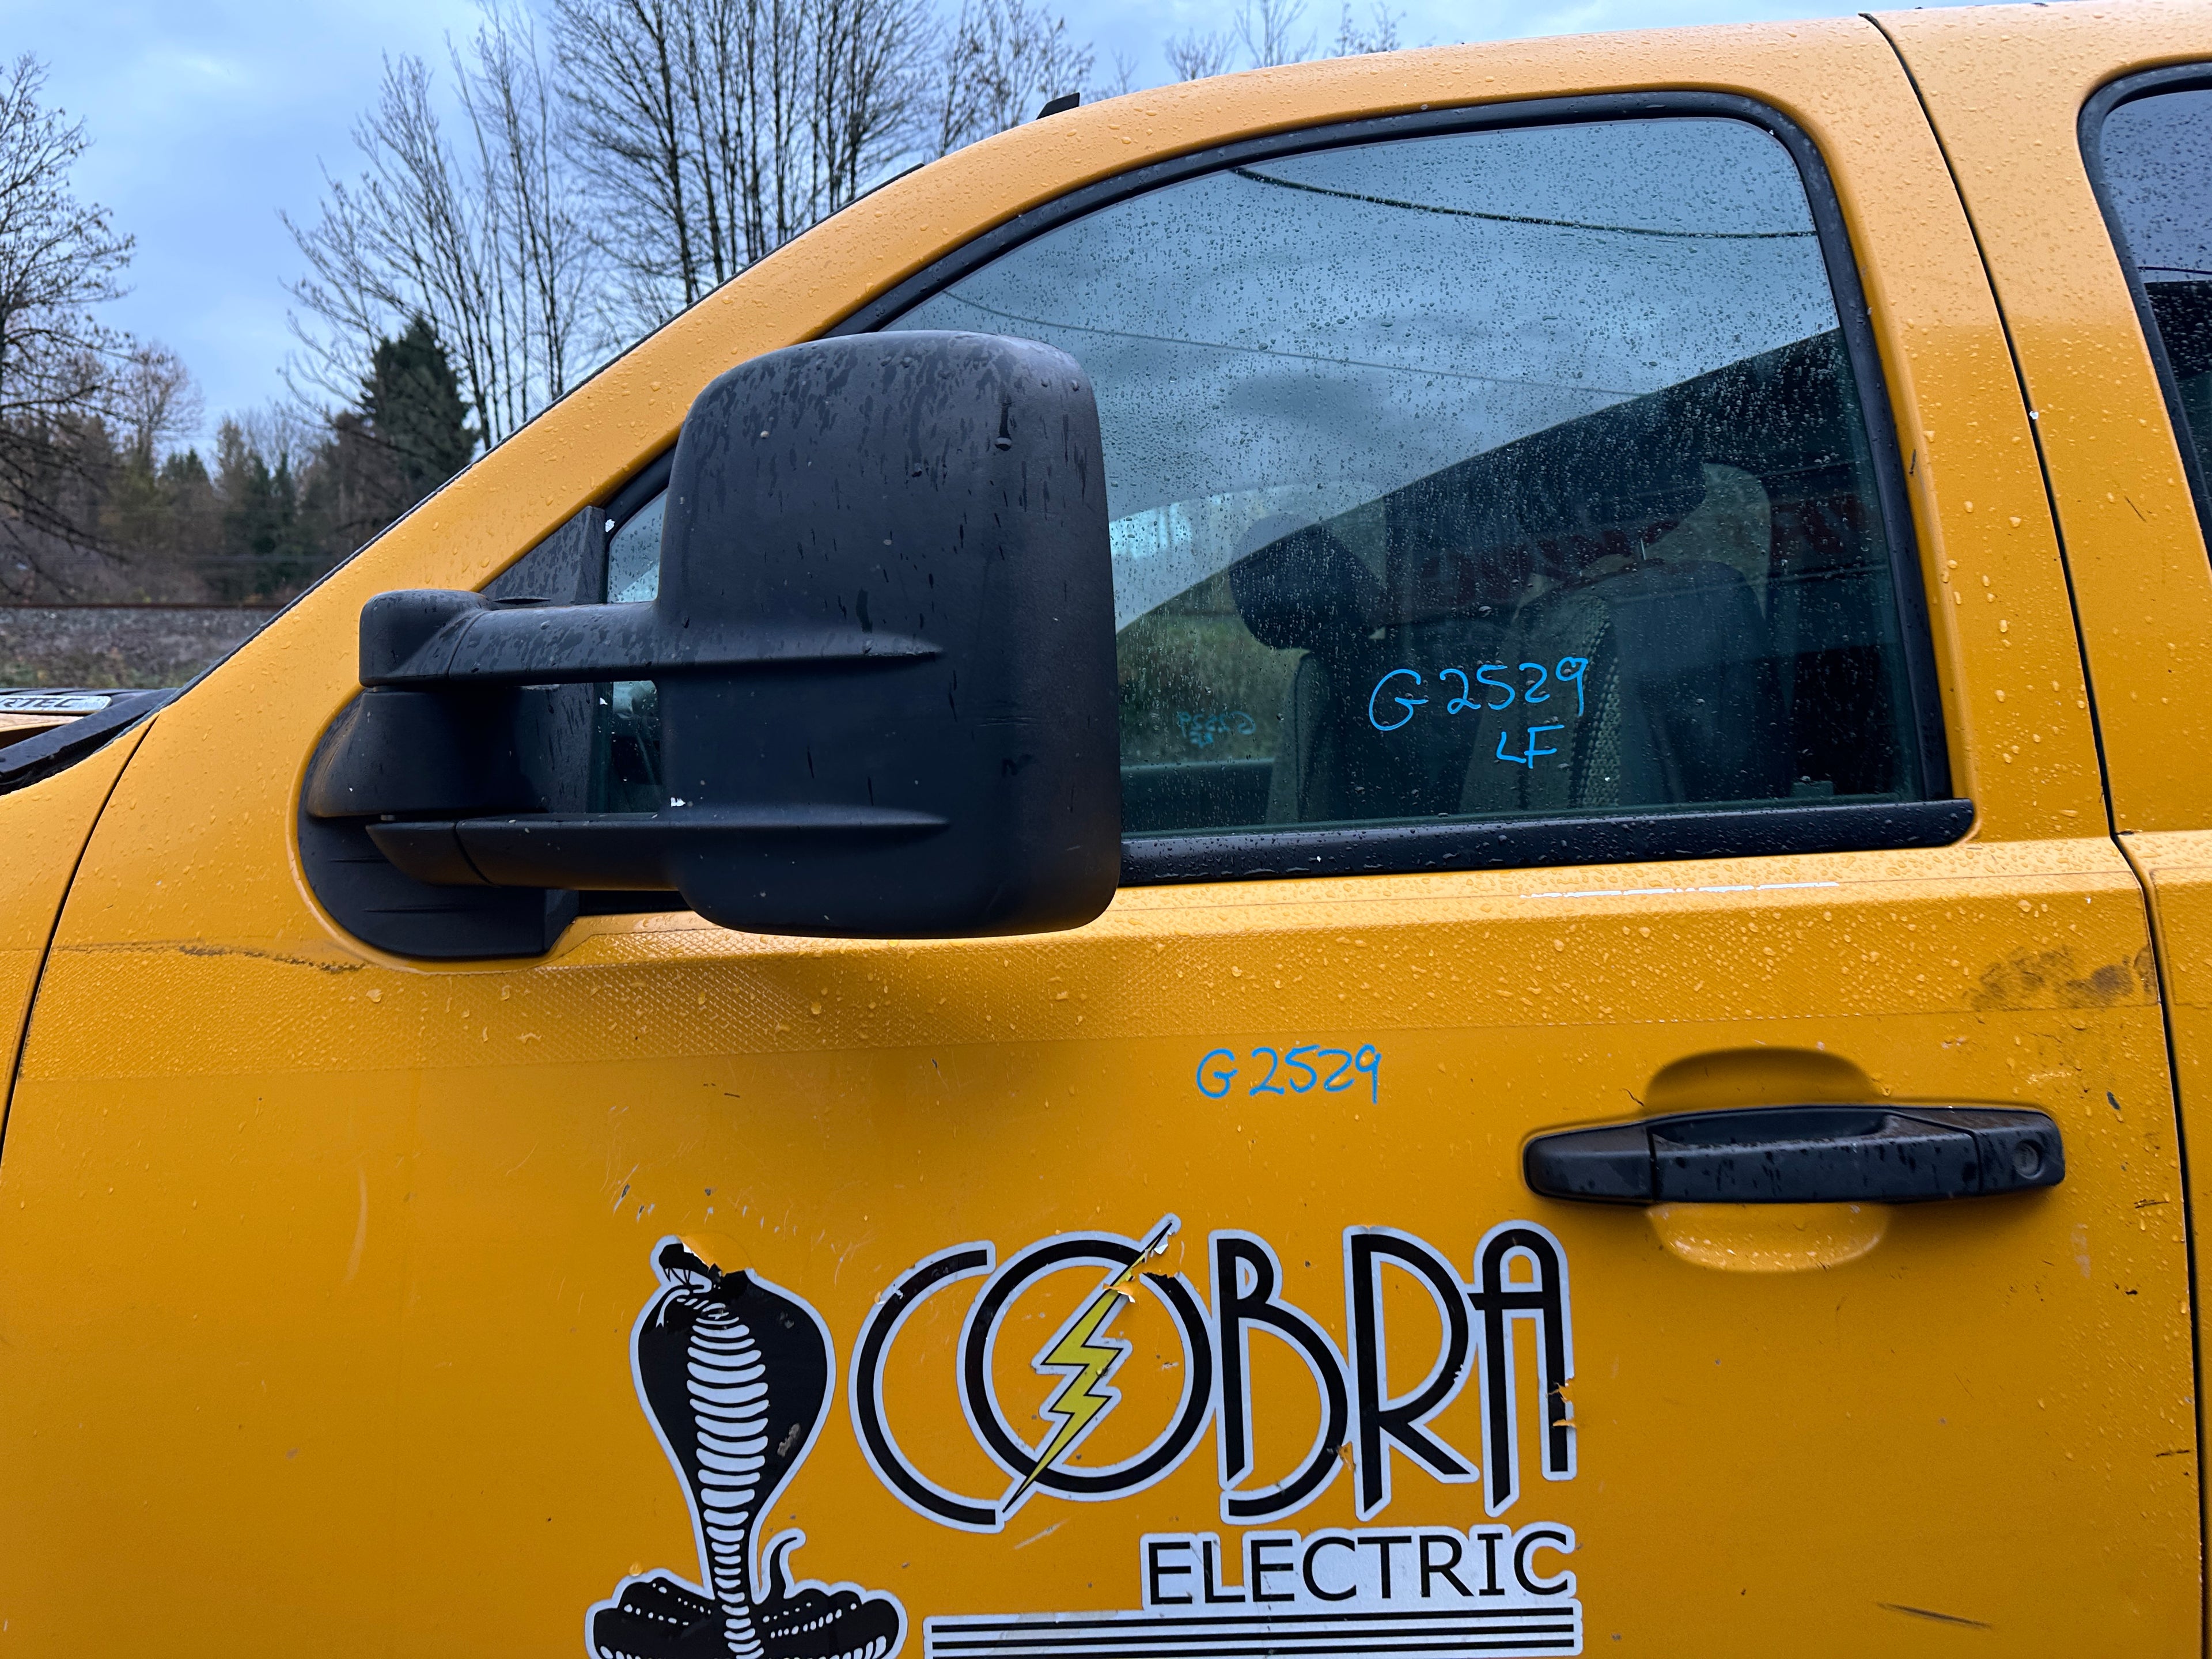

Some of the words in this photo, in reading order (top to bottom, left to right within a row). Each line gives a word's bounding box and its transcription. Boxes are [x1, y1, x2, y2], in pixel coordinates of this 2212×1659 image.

[0, 697, 85, 708] RTEC
[1497, 724, 1565, 769] LF
[855, 1223, 1569, 1526] COBRA
[1147, 1529, 1569, 1606] ELECTRIC
